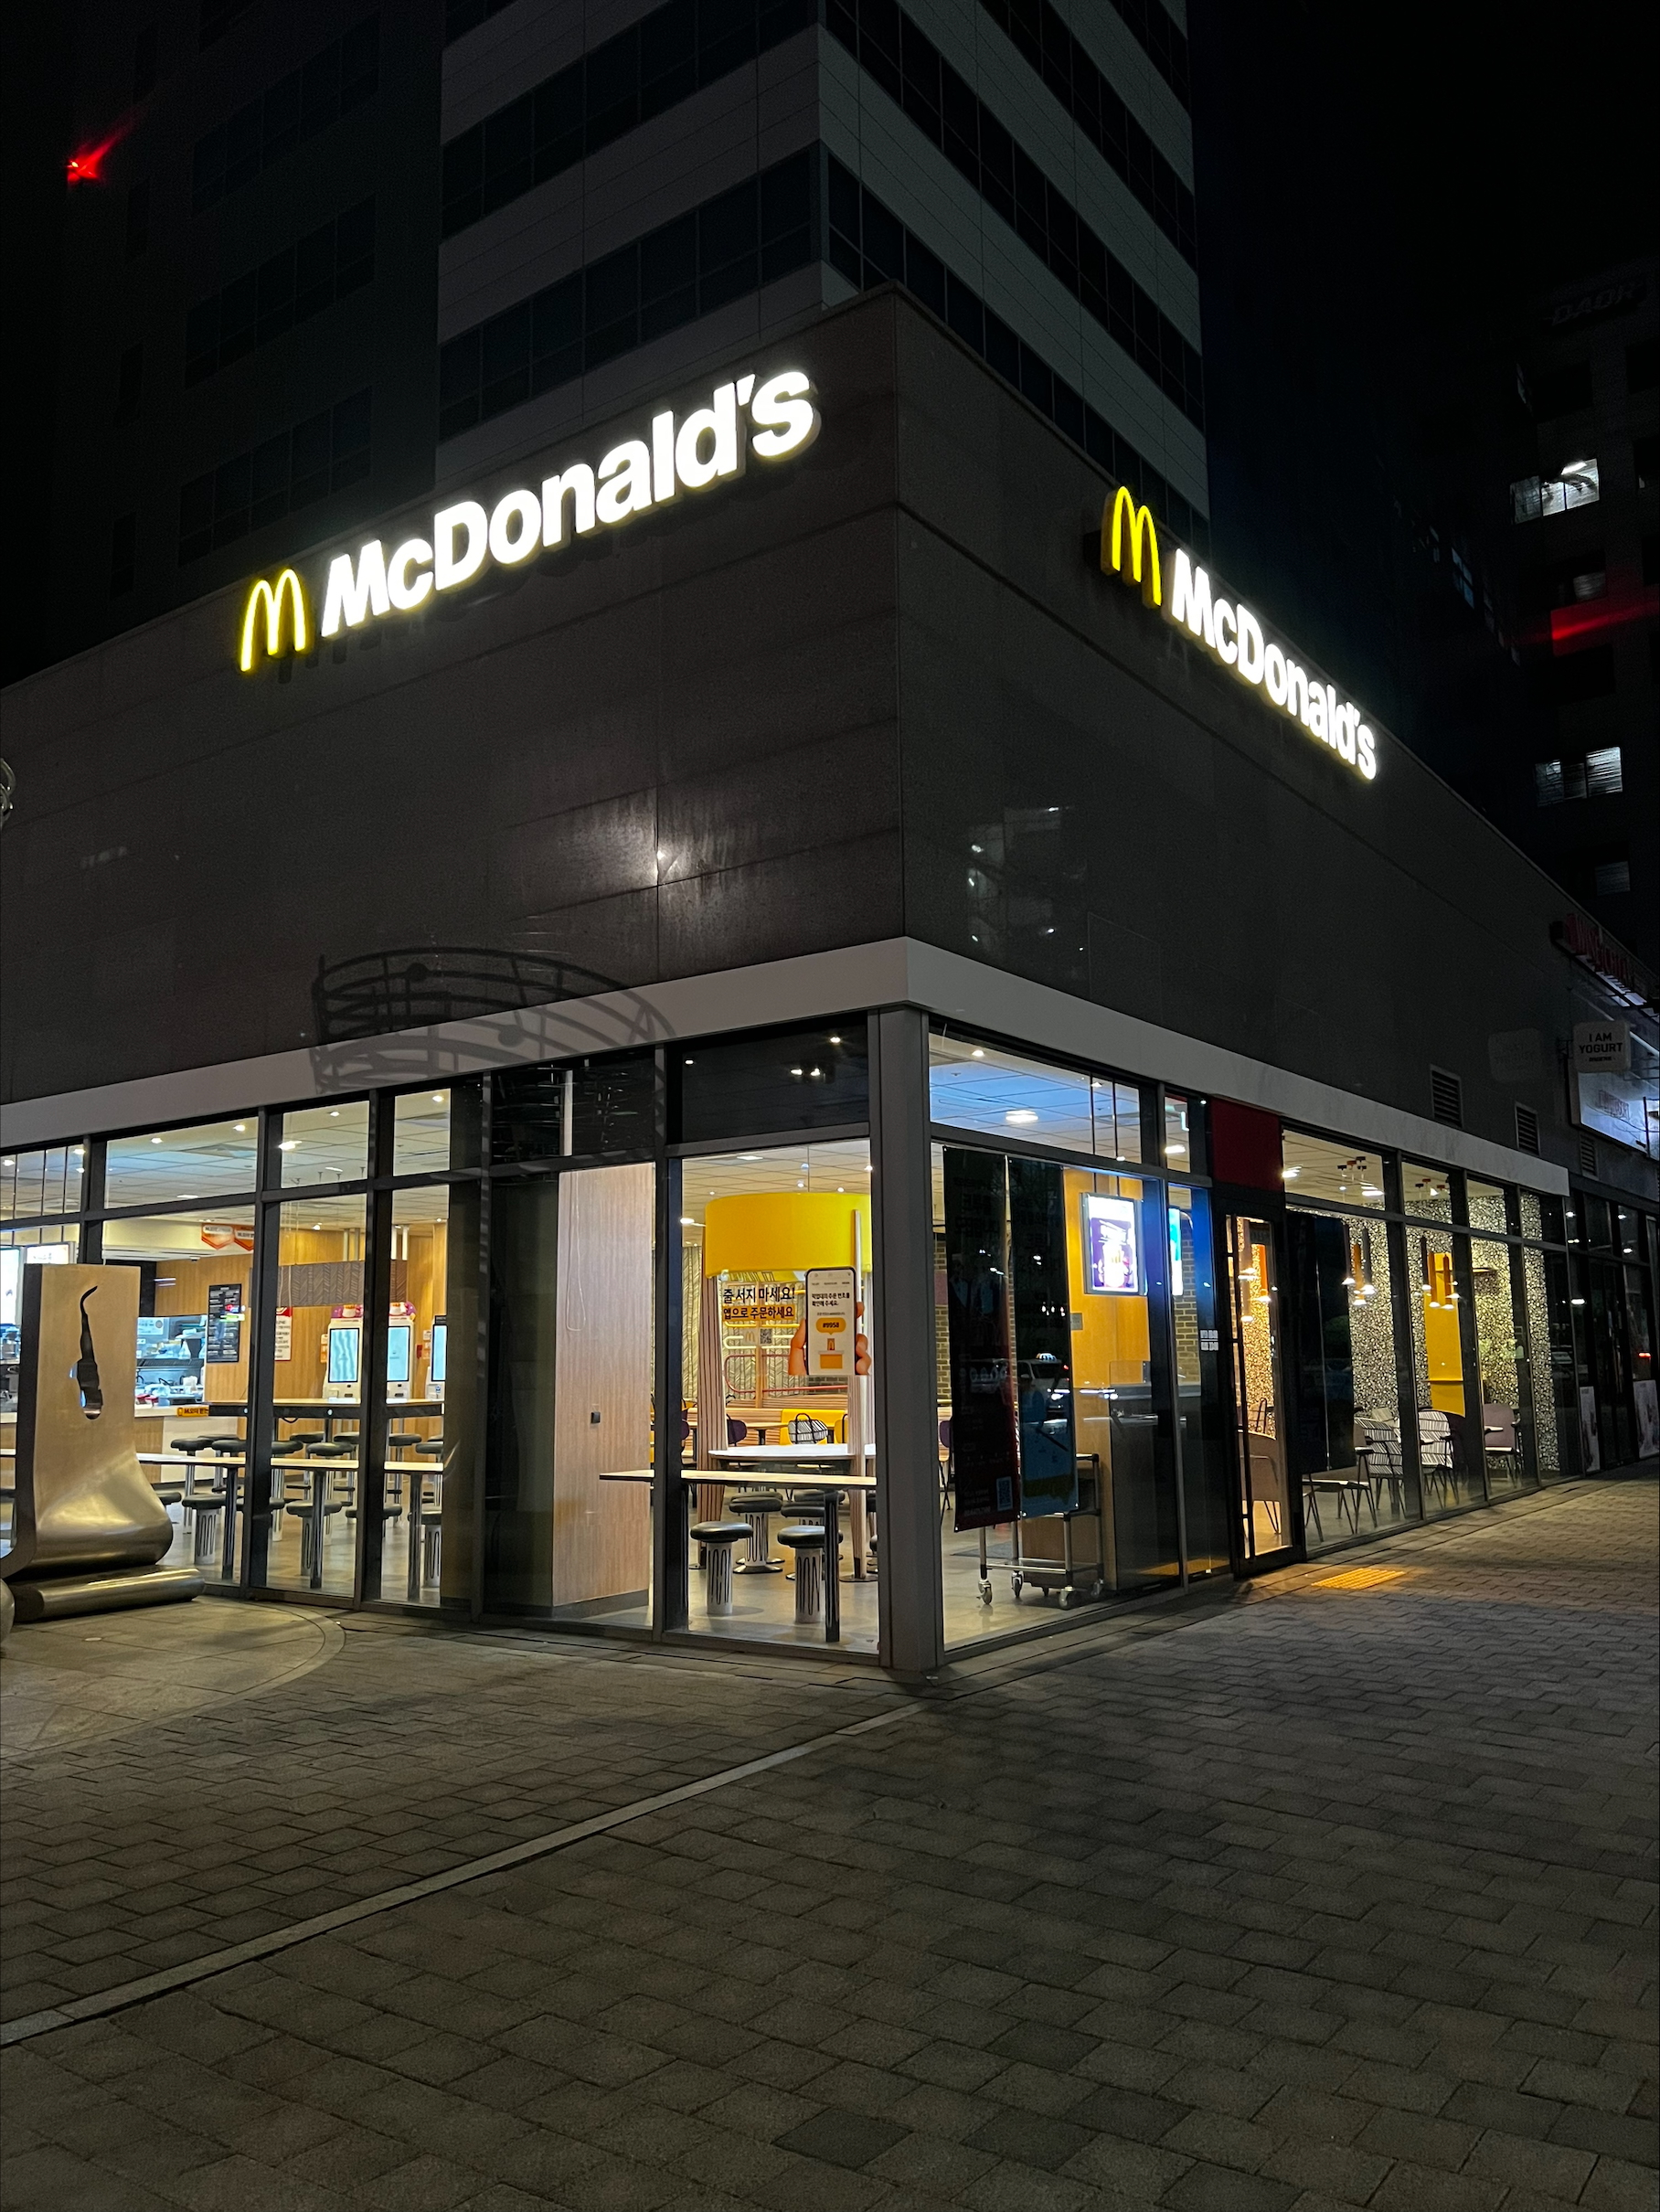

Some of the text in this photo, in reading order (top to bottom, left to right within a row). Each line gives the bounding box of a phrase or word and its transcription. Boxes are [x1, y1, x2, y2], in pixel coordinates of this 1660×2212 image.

[321, 370, 816, 638] McDonald's
[1172, 548, 1377, 781] McDonald's
[1595, 1032, 1612, 1042] AM
[1579, 1042, 1623, 1054] YOGURT
[759, 1286, 795, 1303] 마세요!
[723, 1306, 794, 1320] 앱으로 주문하세요
